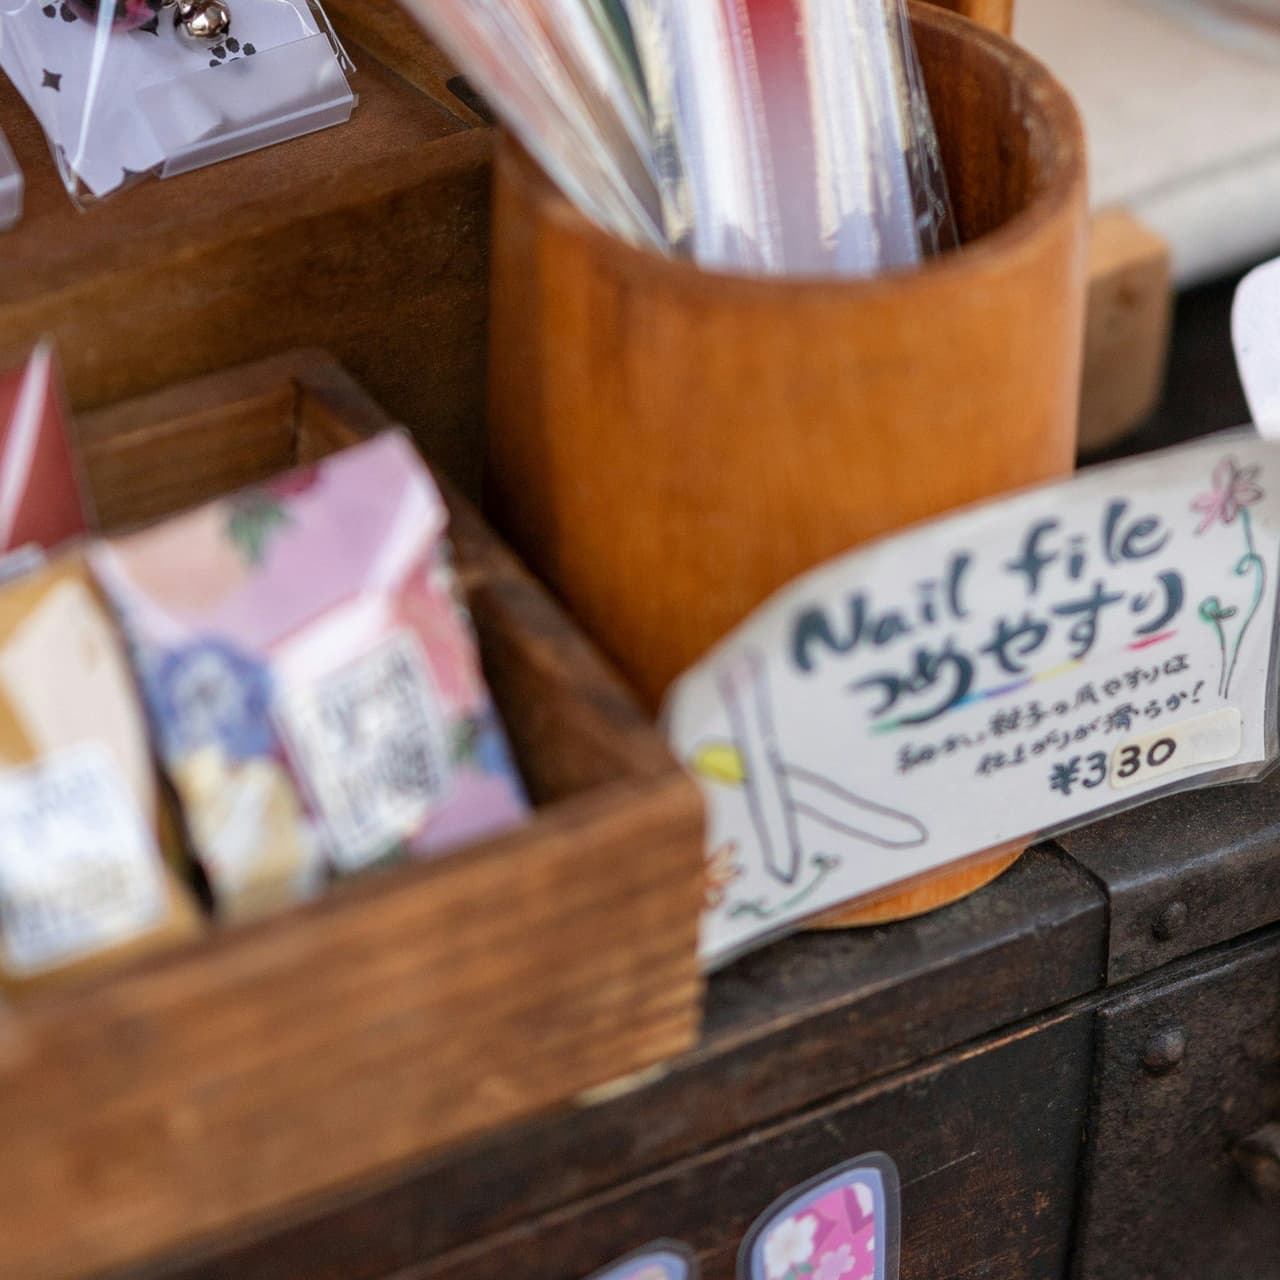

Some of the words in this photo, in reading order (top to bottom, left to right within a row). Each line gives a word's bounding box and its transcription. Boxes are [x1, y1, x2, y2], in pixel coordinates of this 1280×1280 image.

[791, 551, 972, 673] Nail
[1003, 498, 1172, 596] file
[853, 569, 1184, 724] つめやすり
